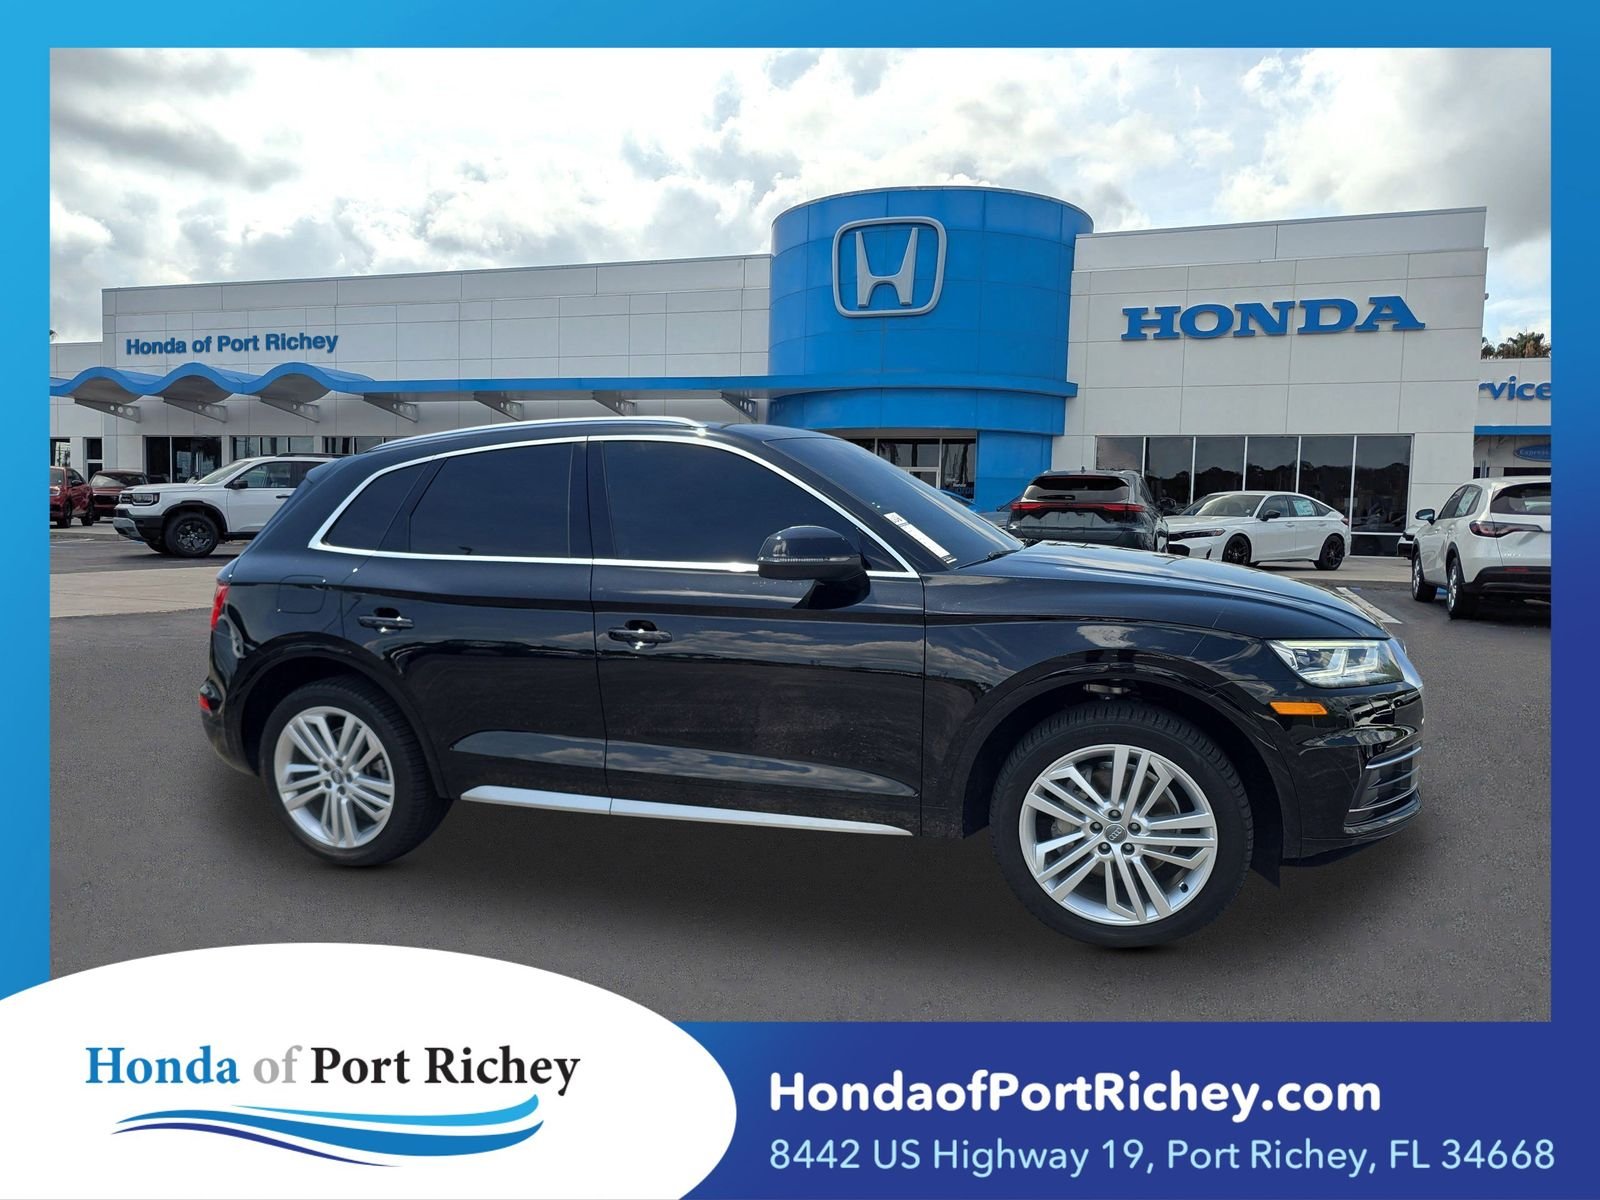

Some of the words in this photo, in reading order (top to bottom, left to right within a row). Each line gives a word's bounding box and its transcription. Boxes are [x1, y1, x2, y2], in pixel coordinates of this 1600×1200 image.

[1121, 295, 1425, 341] HONDA
[125, 337, 187, 355] Honda
[191, 335, 212, 353] of
[217, 334, 259, 352] Port
[265, 331, 339, 353] Richey
